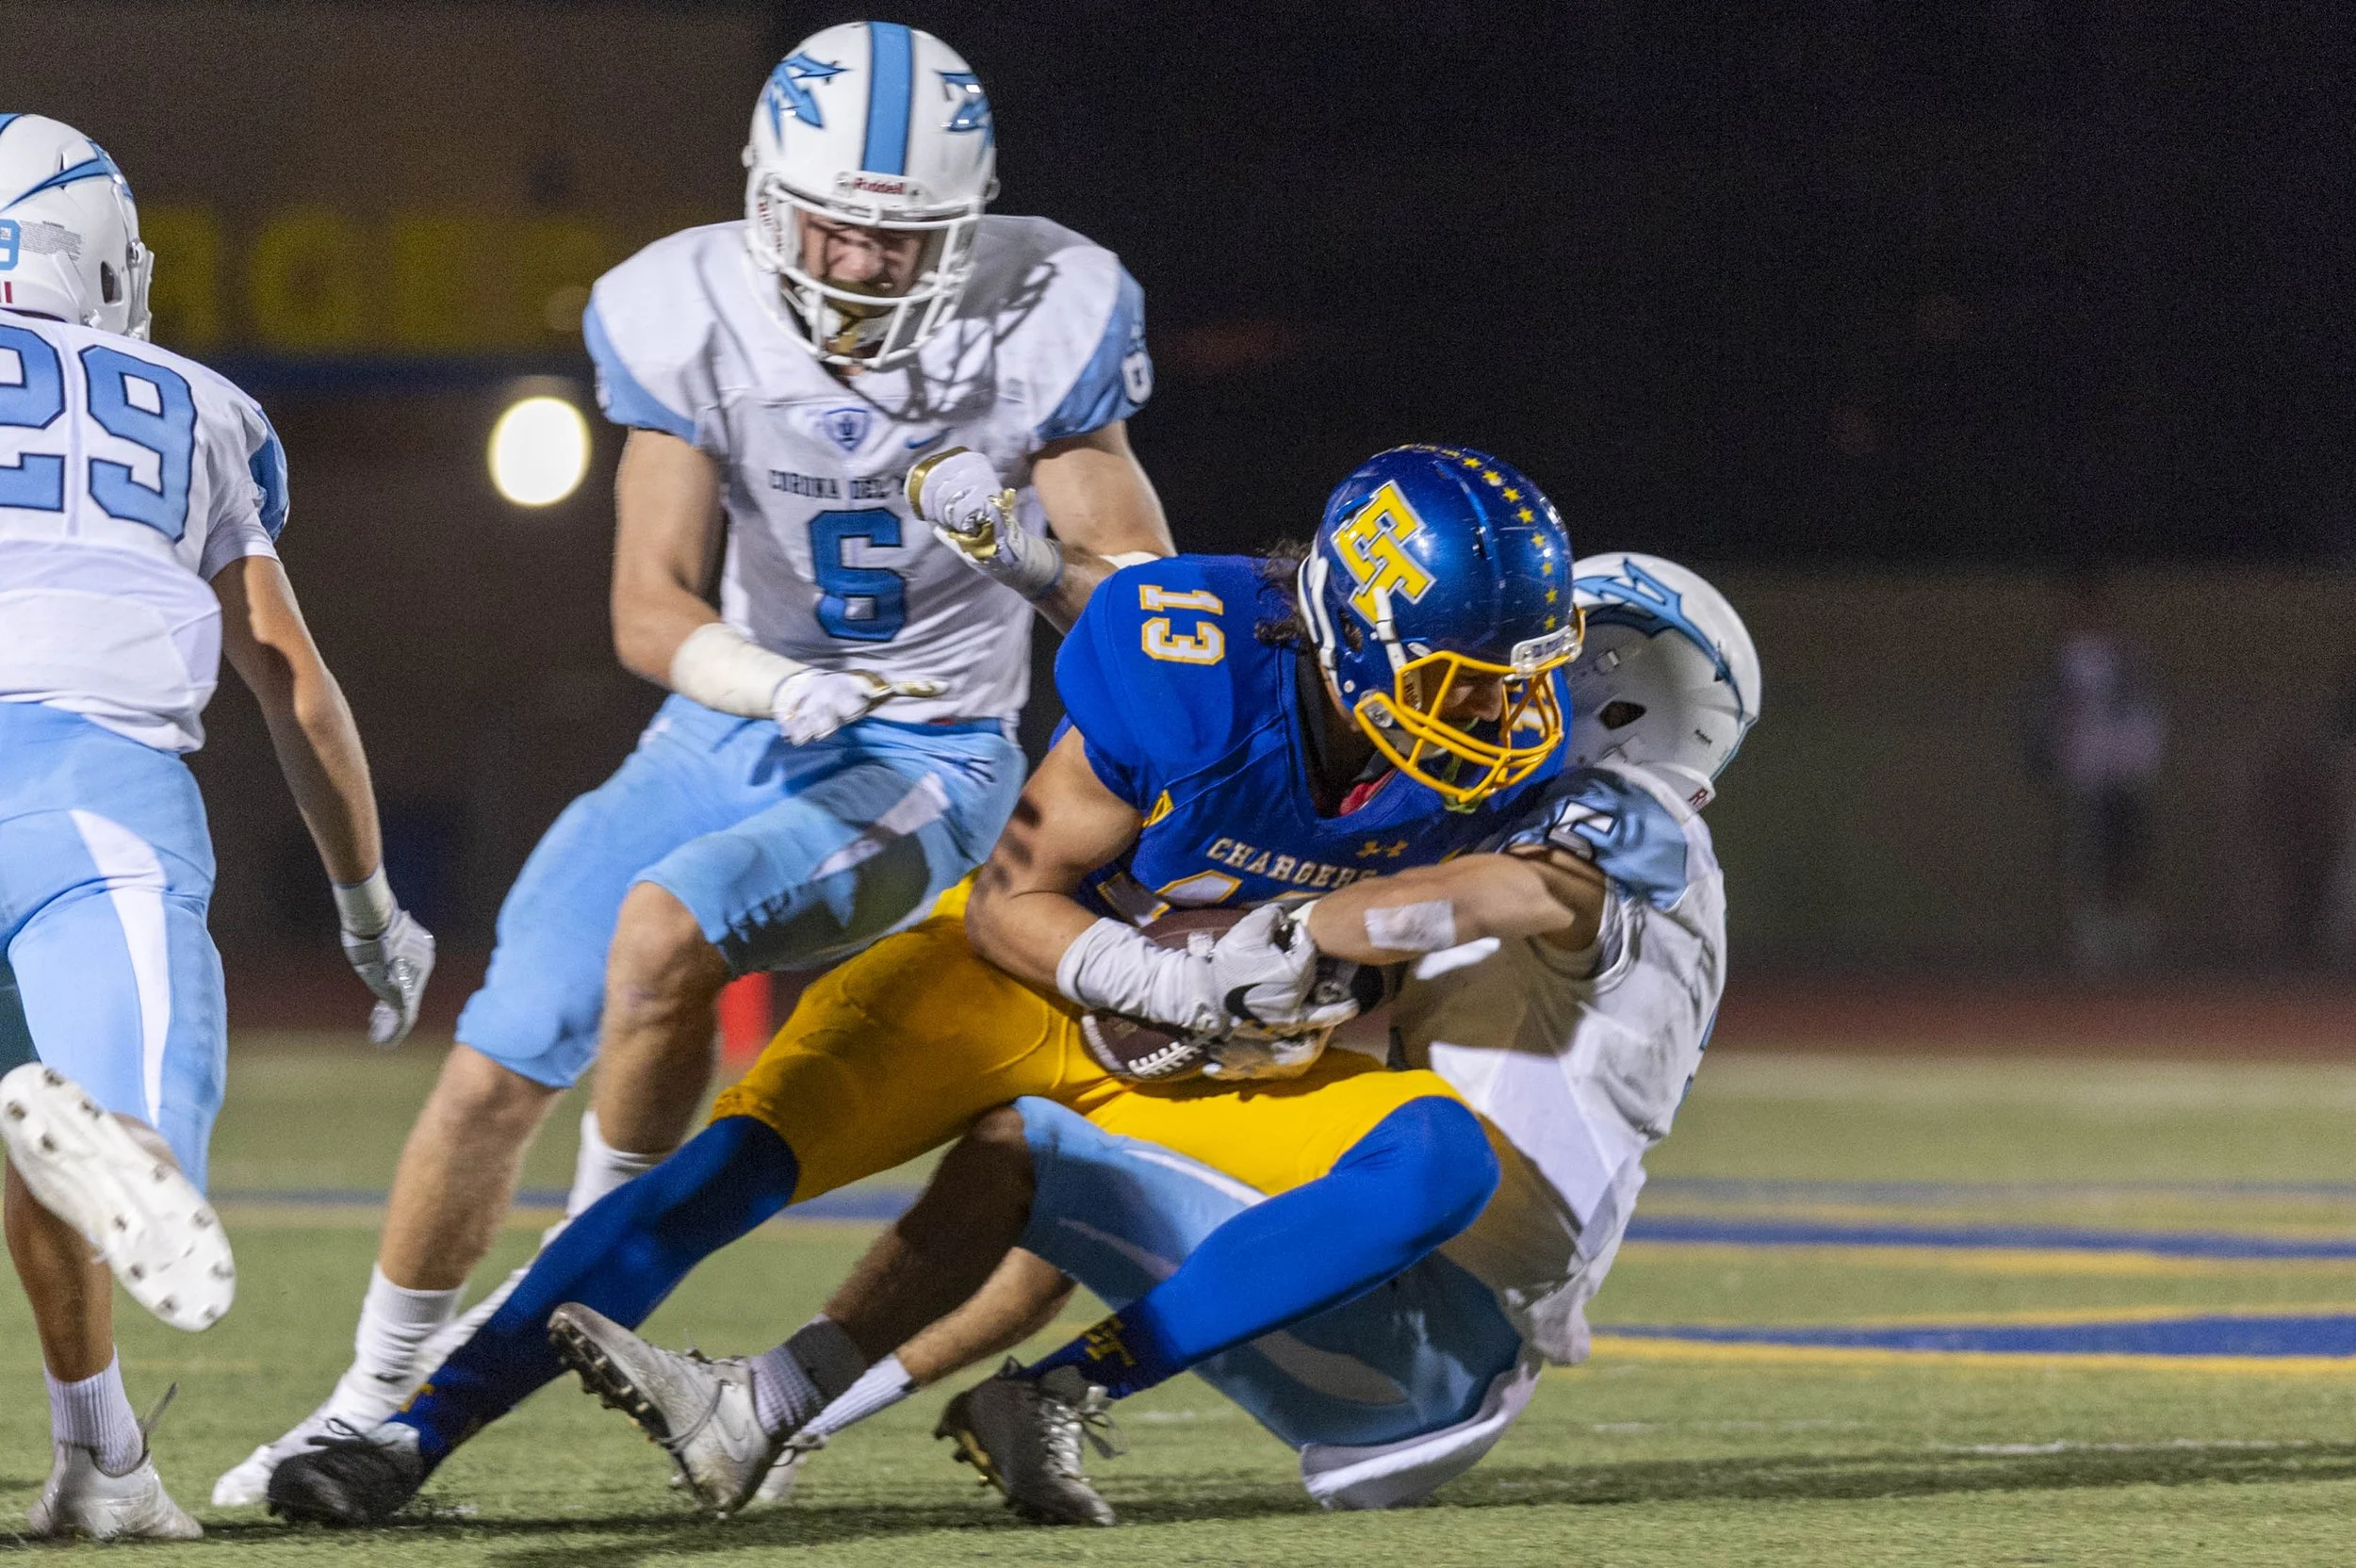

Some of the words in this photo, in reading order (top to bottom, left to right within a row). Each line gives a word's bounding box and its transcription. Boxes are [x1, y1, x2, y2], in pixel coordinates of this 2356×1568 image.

[0, 323, 198, 544] 29
[809, 506, 908, 643] 6
[1138, 584, 1225, 665] 13
